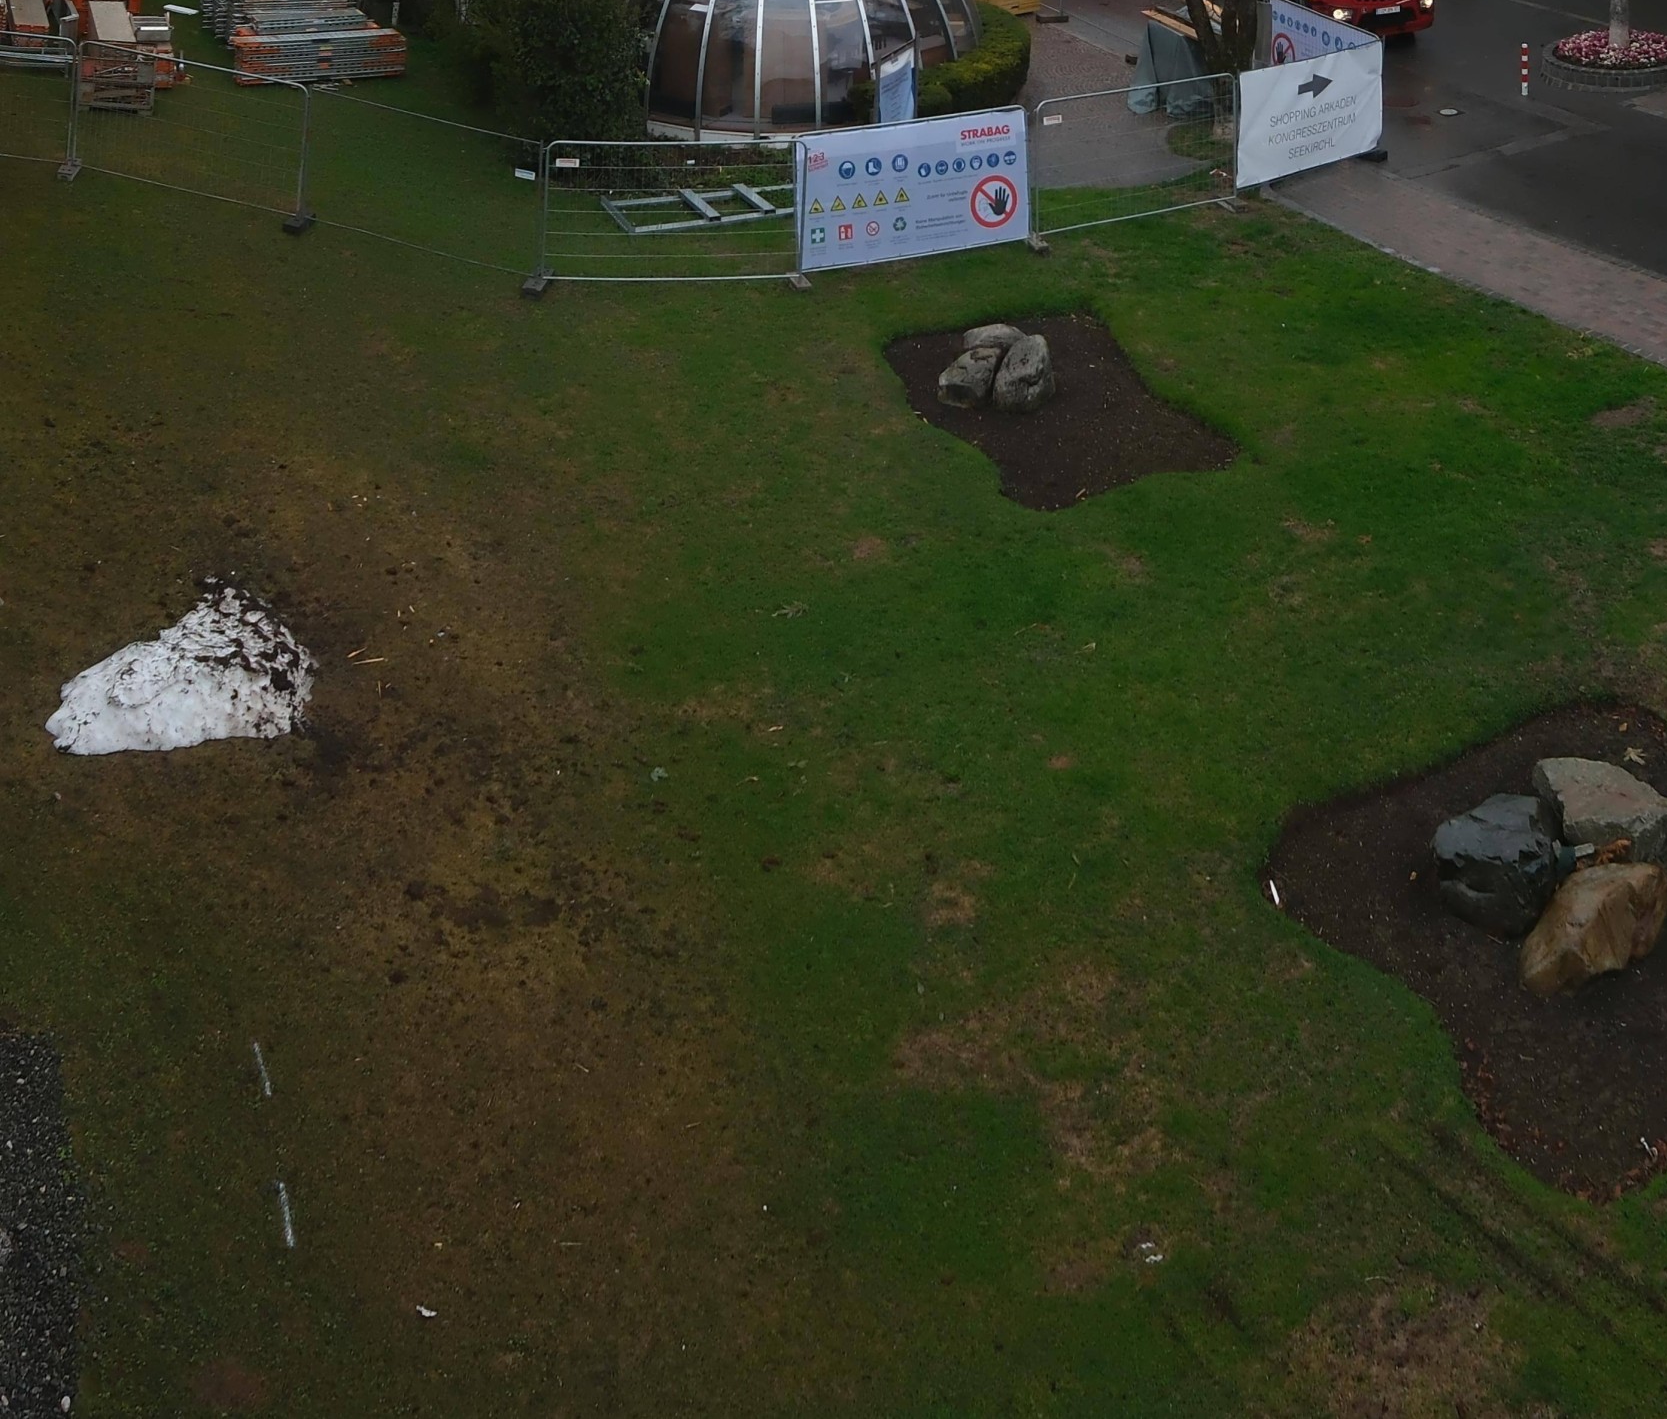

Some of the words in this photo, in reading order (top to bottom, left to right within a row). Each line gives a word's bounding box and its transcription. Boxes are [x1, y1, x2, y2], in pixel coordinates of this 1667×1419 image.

[1269, 106, 1316, 128] SHOPPING
[1318, 95, 1357, 116] ARKADEN
[960, 125, 1010, 141] STRABAG
[1268, 113, 1356, 146] KONGRESSZENTRUM
[1288, 137, 1336, 160] SEEKIRCHL
